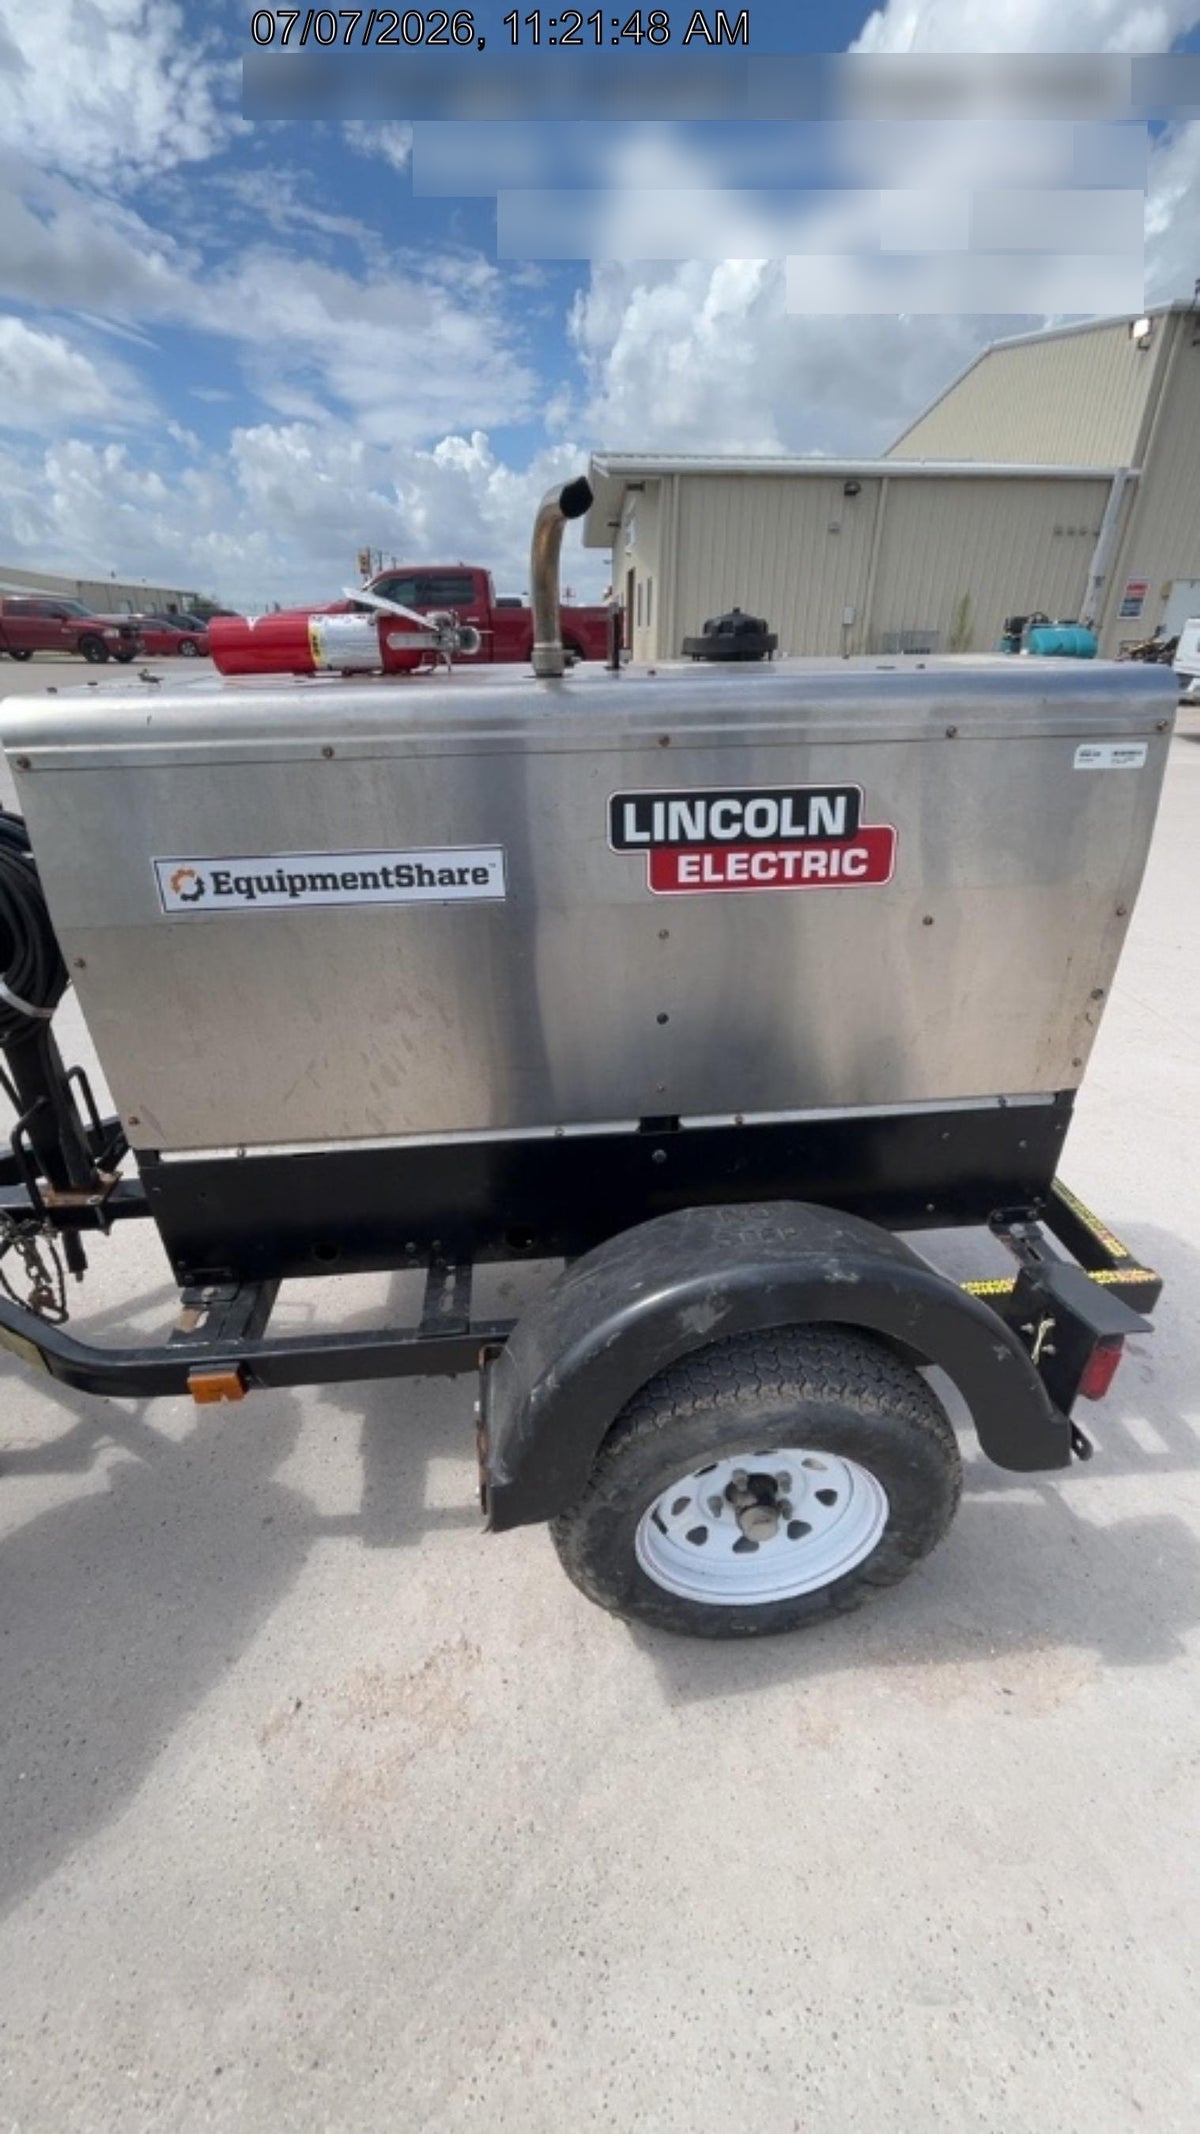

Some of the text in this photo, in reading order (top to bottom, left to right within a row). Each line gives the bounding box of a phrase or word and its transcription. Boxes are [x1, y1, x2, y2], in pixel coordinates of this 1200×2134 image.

[623, 796, 847, 843] LINCOLN
[210, 863, 490, 900] EquipmentShare
[677, 848, 869, 883] ELECTRIC
